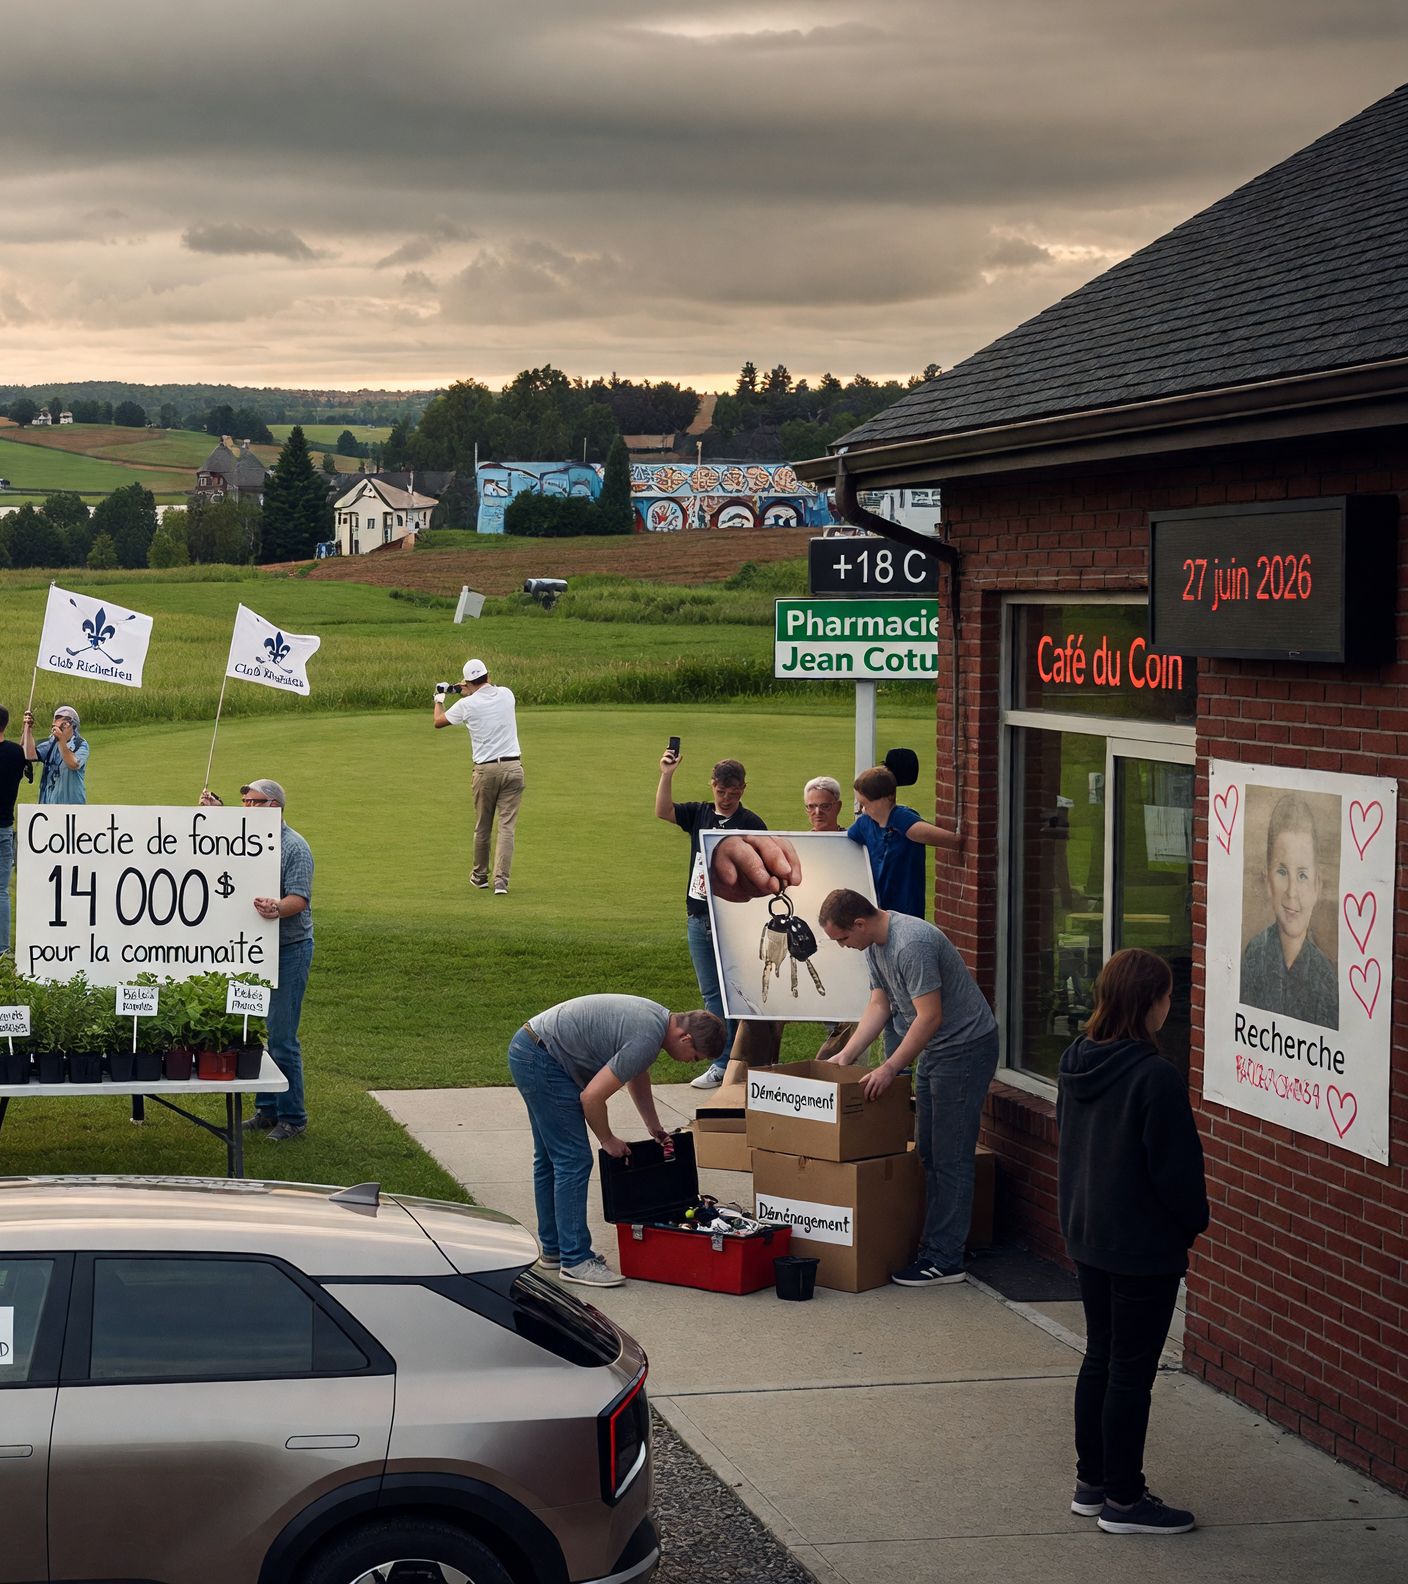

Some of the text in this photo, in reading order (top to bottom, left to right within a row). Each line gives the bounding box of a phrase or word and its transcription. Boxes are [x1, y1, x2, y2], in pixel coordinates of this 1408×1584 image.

[833, 550, 926, 583] +18 C
[1183, 554, 1311, 611] 27 juin 2026
[787, 609, 938, 636] Pharmacie
[784, 648, 853, 671] Jean
[1038, 635, 1182, 688] Café du Coin
[29, 813, 274, 856] Collecte de fonds:
[49, 865, 96, 926] 14
[29, 932, 264, 977] pour la communaité
[1235, 1013, 1345, 1075] Recherche
